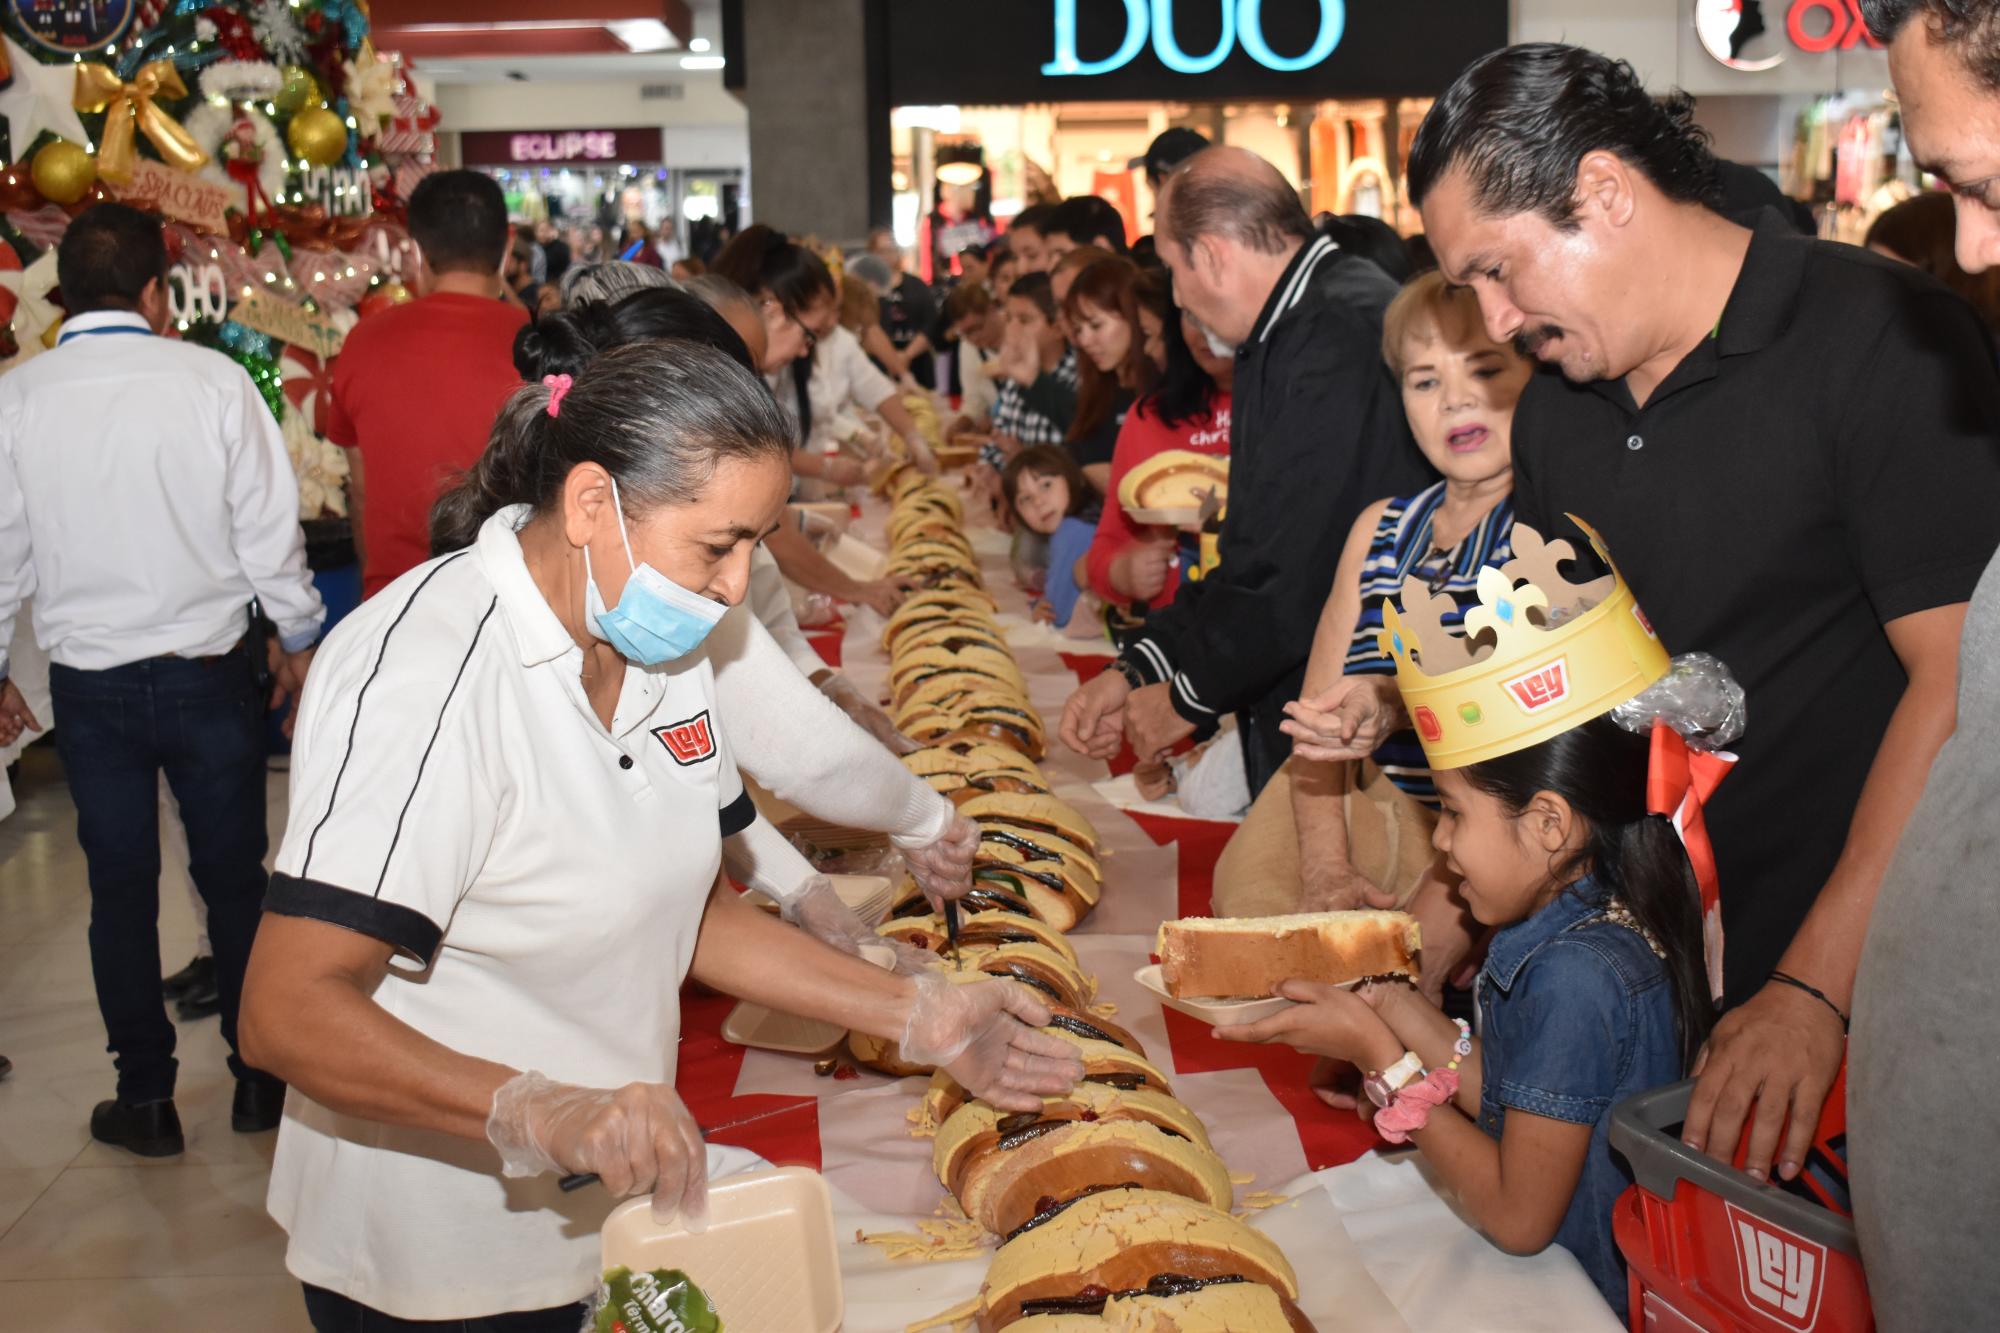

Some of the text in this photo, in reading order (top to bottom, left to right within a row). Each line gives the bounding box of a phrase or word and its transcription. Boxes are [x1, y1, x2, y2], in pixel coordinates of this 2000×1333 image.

[1041, 0, 1345, 76] DUO
[511, 131, 616, 160] ECLIPSE
[1216, 409, 1232, 429] H
